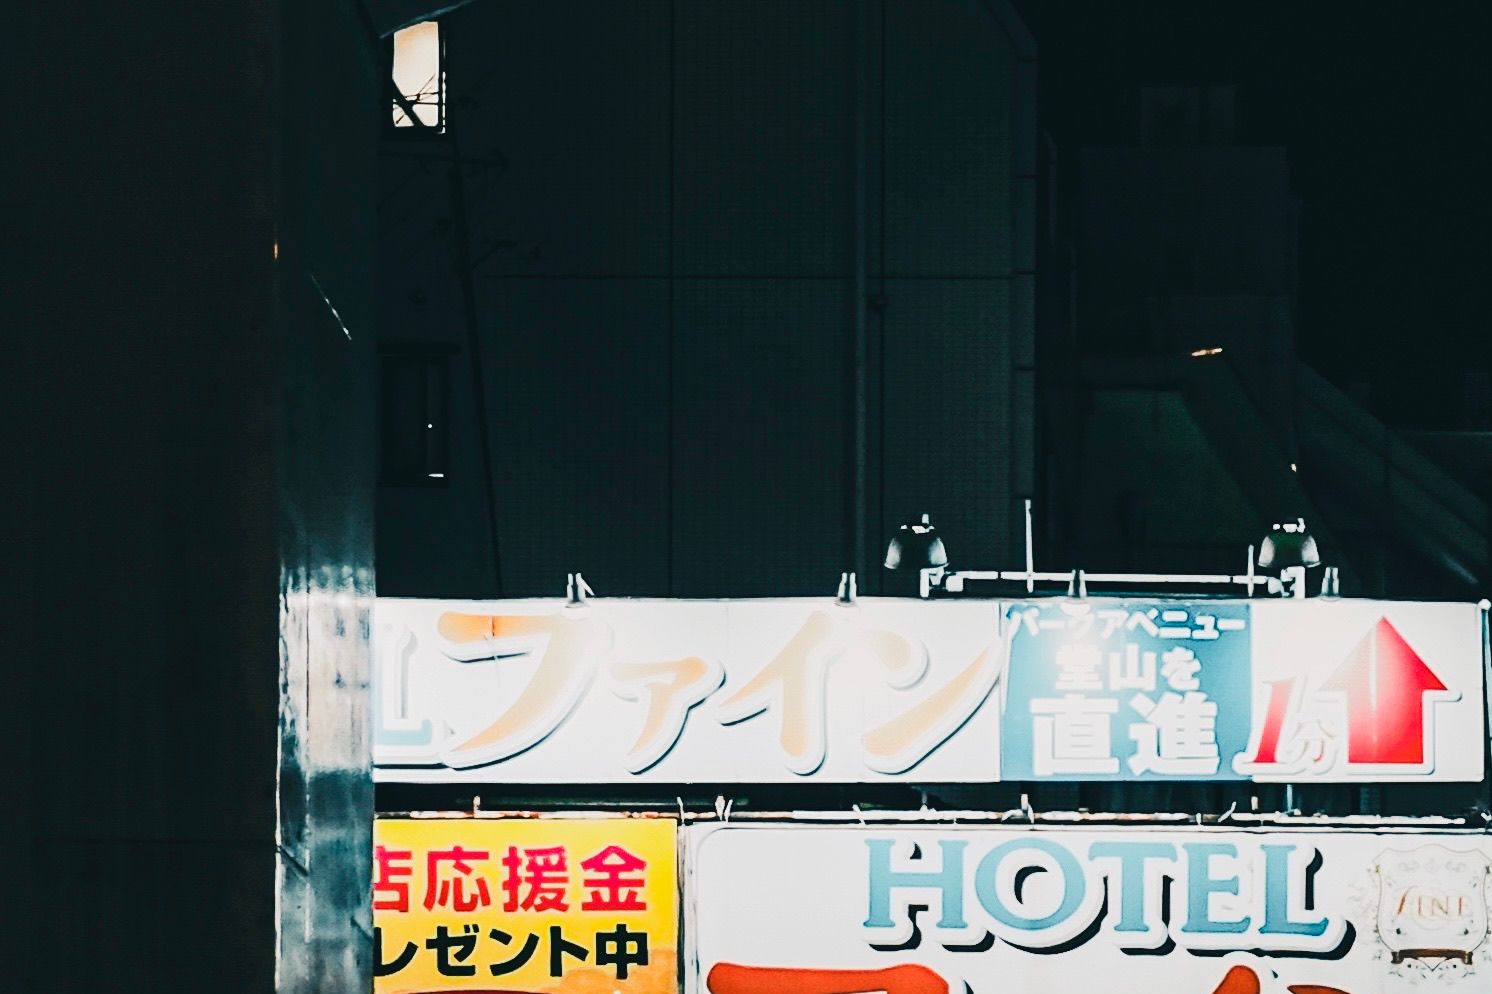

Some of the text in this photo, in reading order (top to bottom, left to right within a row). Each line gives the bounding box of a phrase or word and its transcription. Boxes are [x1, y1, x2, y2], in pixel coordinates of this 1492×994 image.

[1005, 603, 1246, 641] パークアベニュー
[435, 608, 1000, 773] ファイン
[1054, 642, 1202, 692] 堂山を
[1029, 691, 1222, 777] 直進
[1232, 674, 1341, 776] 1分
[374, 845, 648, 913] 店応援金
[862, 837, 1345, 950] HOTEL
[374, 923, 649, 979] レゼント中
